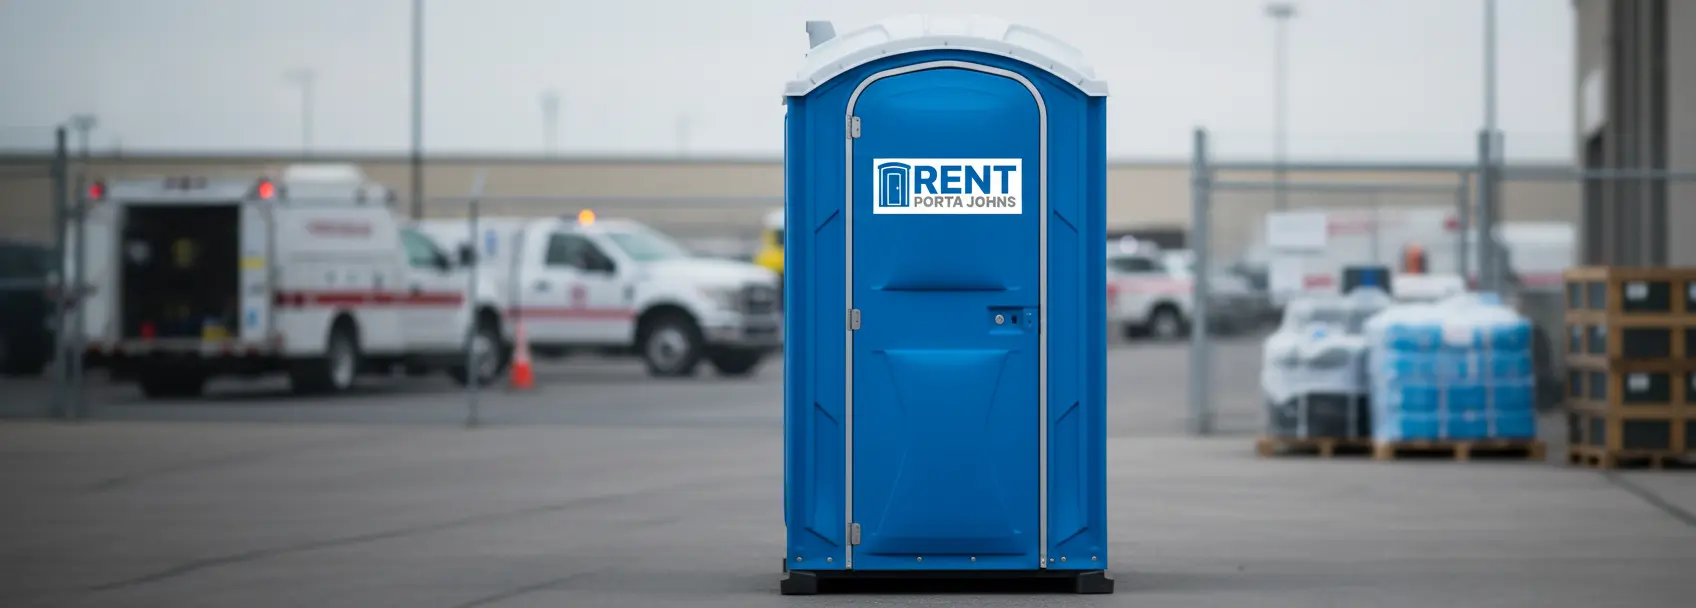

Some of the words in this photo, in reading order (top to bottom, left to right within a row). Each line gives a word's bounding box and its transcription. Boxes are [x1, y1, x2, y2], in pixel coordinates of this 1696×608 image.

[914, 165, 1017, 194] RENT
[914, 196, 963, 207] PORTA
[966, 196, 1016, 207] JOHNS
